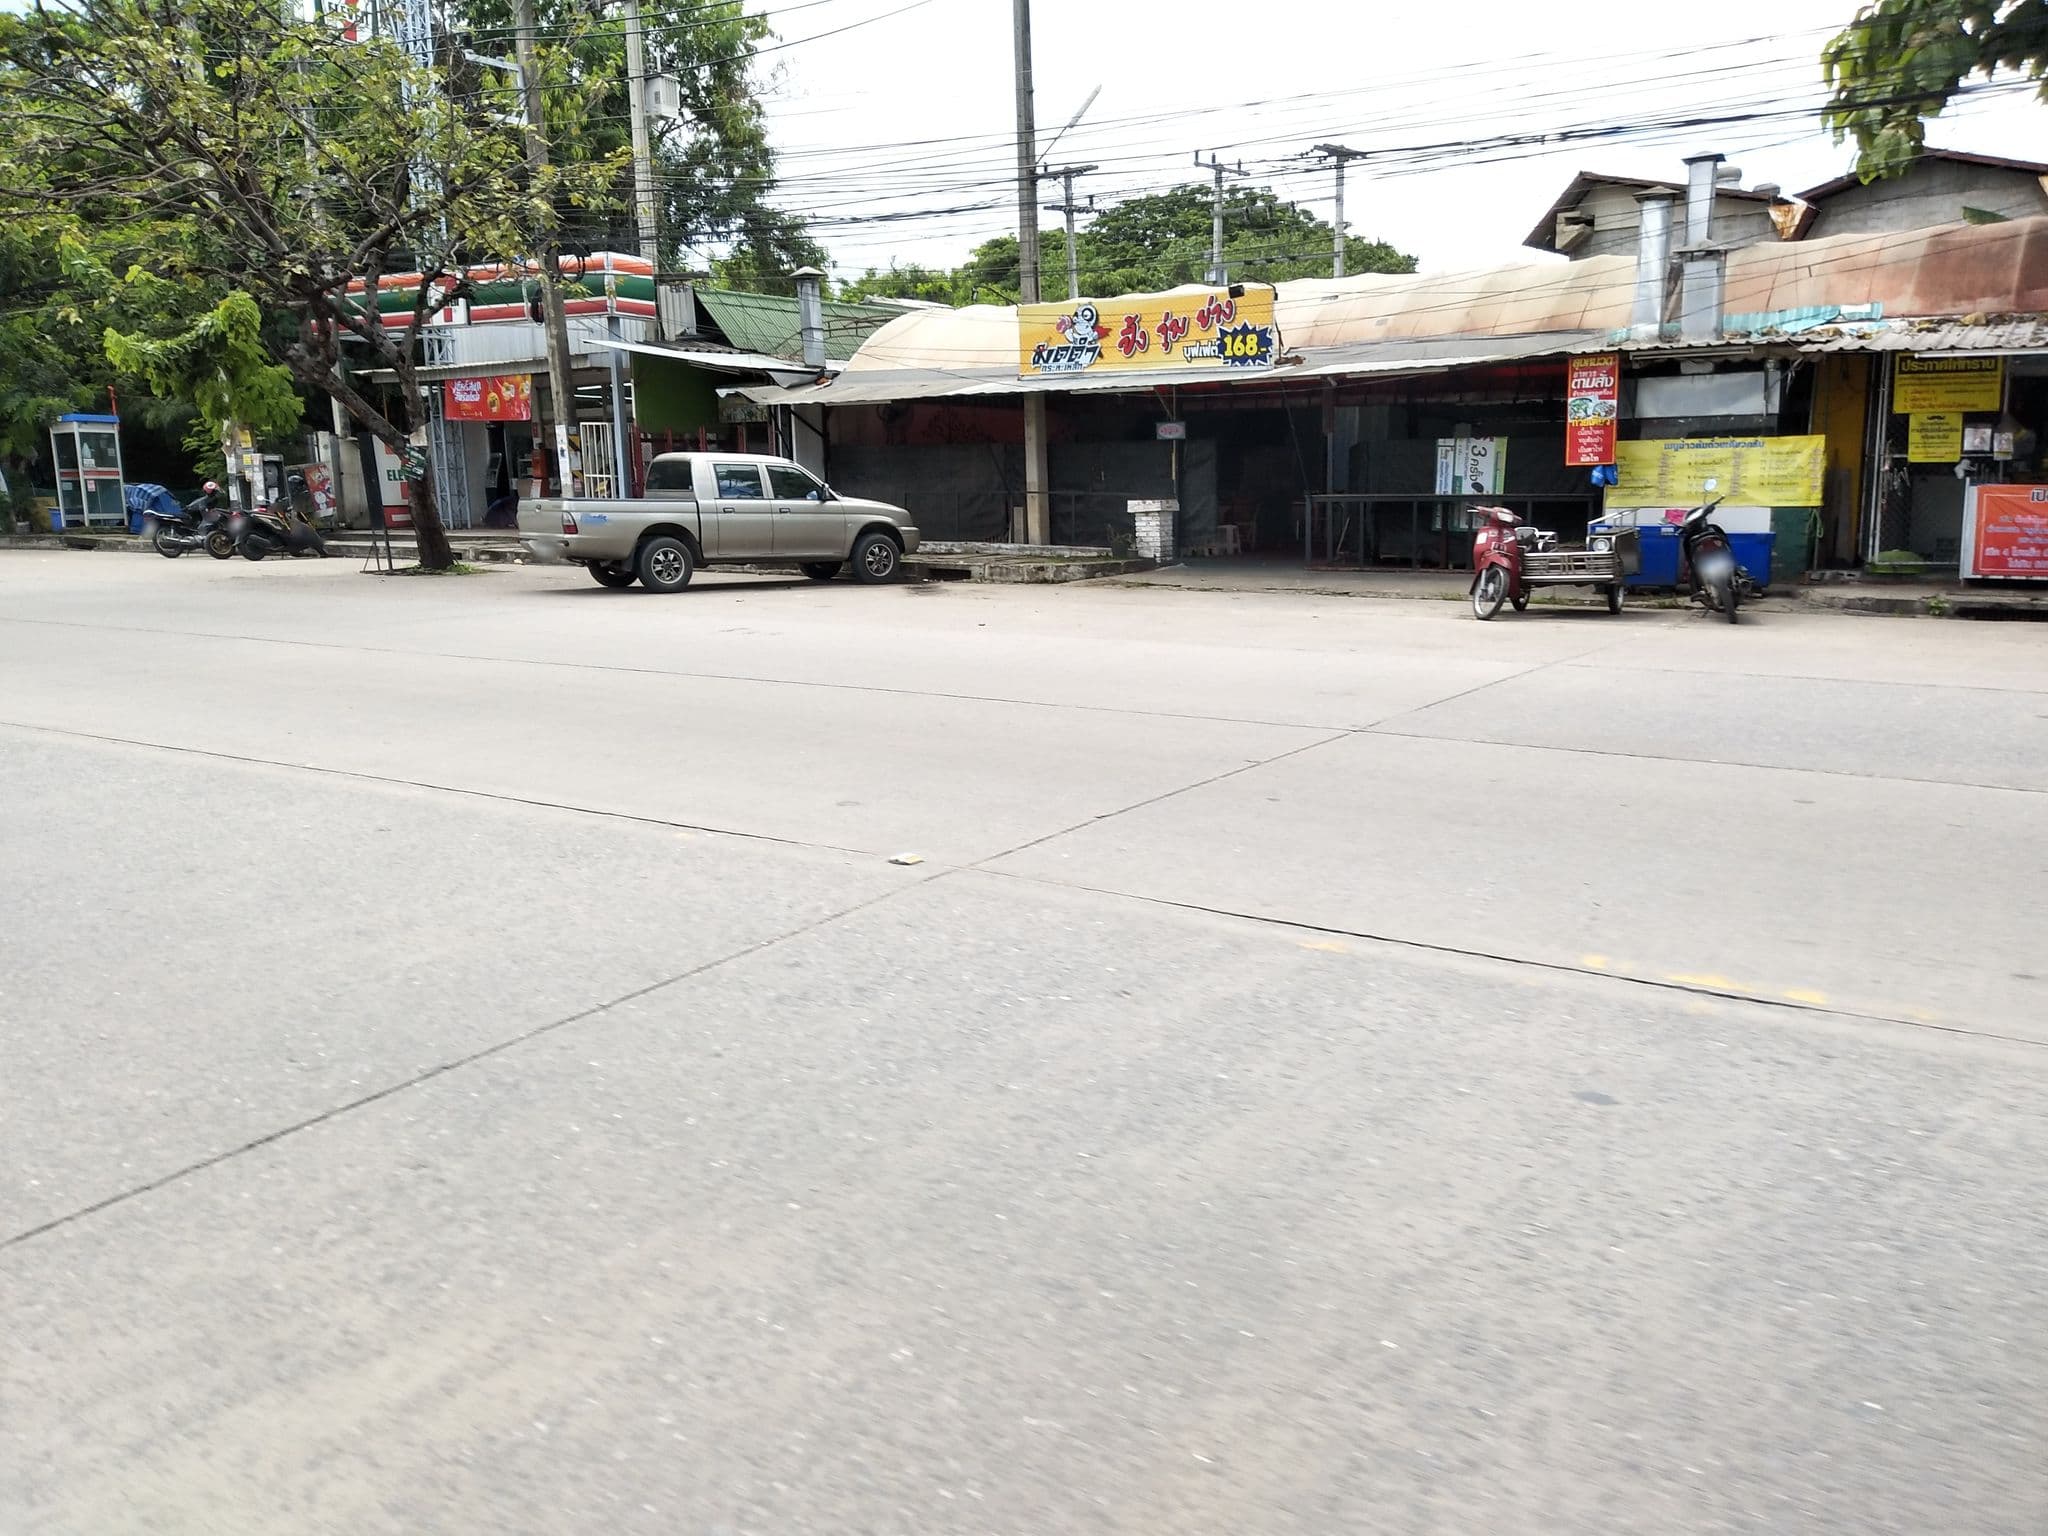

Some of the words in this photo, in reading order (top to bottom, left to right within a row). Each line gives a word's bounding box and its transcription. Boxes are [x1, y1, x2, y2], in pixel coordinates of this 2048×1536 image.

[1196, 295, 1235, 329] ย่าง
[1572, 370, 1614, 388] ตามสั่ง
[1471, 445, 1487, 457] 3
